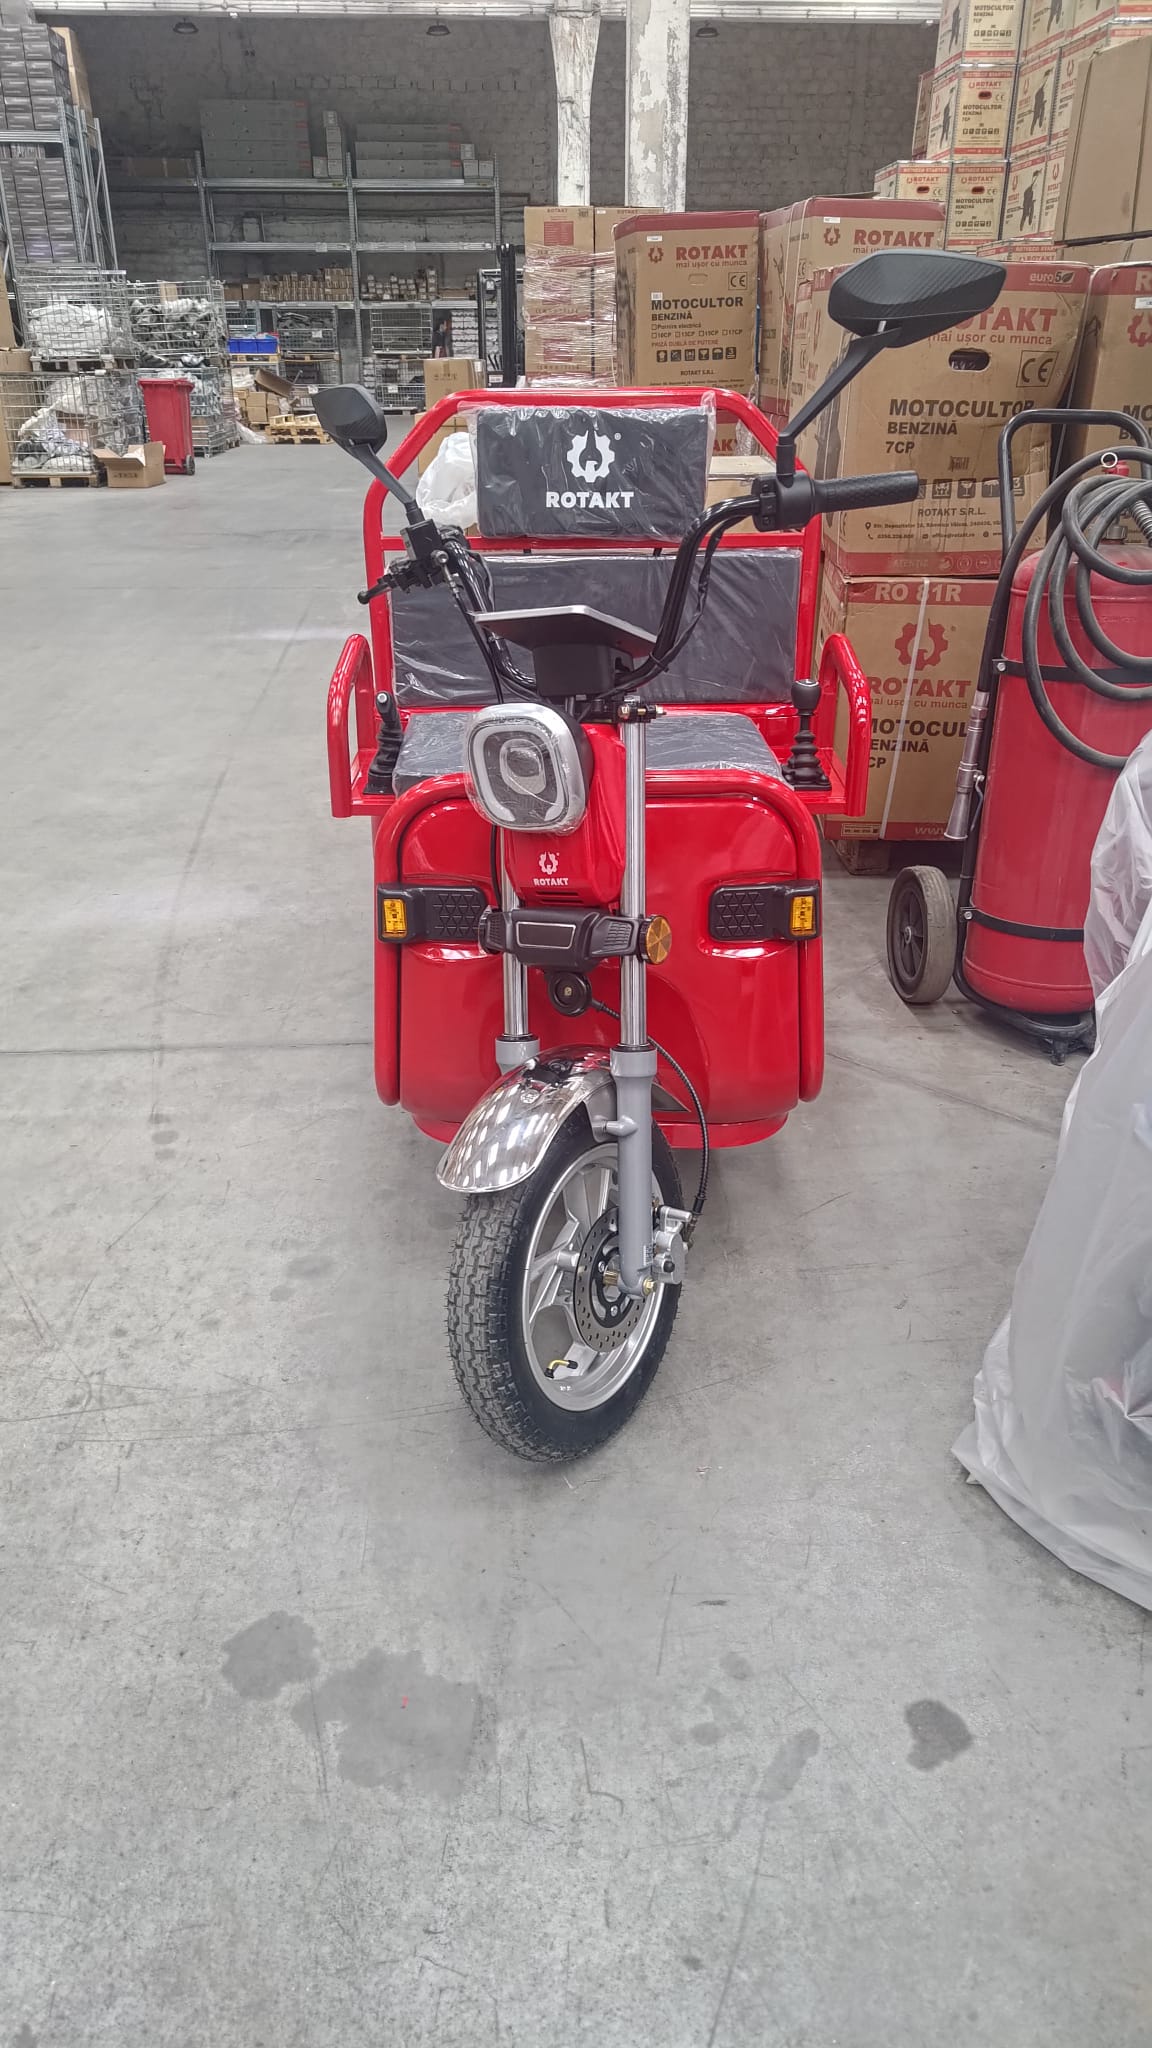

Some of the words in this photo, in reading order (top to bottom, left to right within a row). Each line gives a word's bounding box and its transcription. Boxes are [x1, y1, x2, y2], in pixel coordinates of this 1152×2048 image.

[854, 229, 935, 247] ROTAKT
[676, 244, 748, 261] ROTAKT
[676, 261, 690, 269] mai
[651, 296, 744, 311] MOTOCULTOR
[990, 334, 1005, 344] cu
[889, 399, 1035, 418] MOTOCULTOR
[887, 420, 958, 435] BENZINĂ
[885, 441, 915, 454] 7CP
[546, 491, 634, 508] ROTAKT
[918, 508, 957, 517] ROTAKT
[959, 507, 986, 516] S.R.L.
[875, 583, 909, 602] RO
[867, 676, 972, 698] ROTAKT
[914, 700, 927, 708] cu
[870, 738, 930, 753] ENZINĂ
[533, 877, 569, 886] ROTAKT
